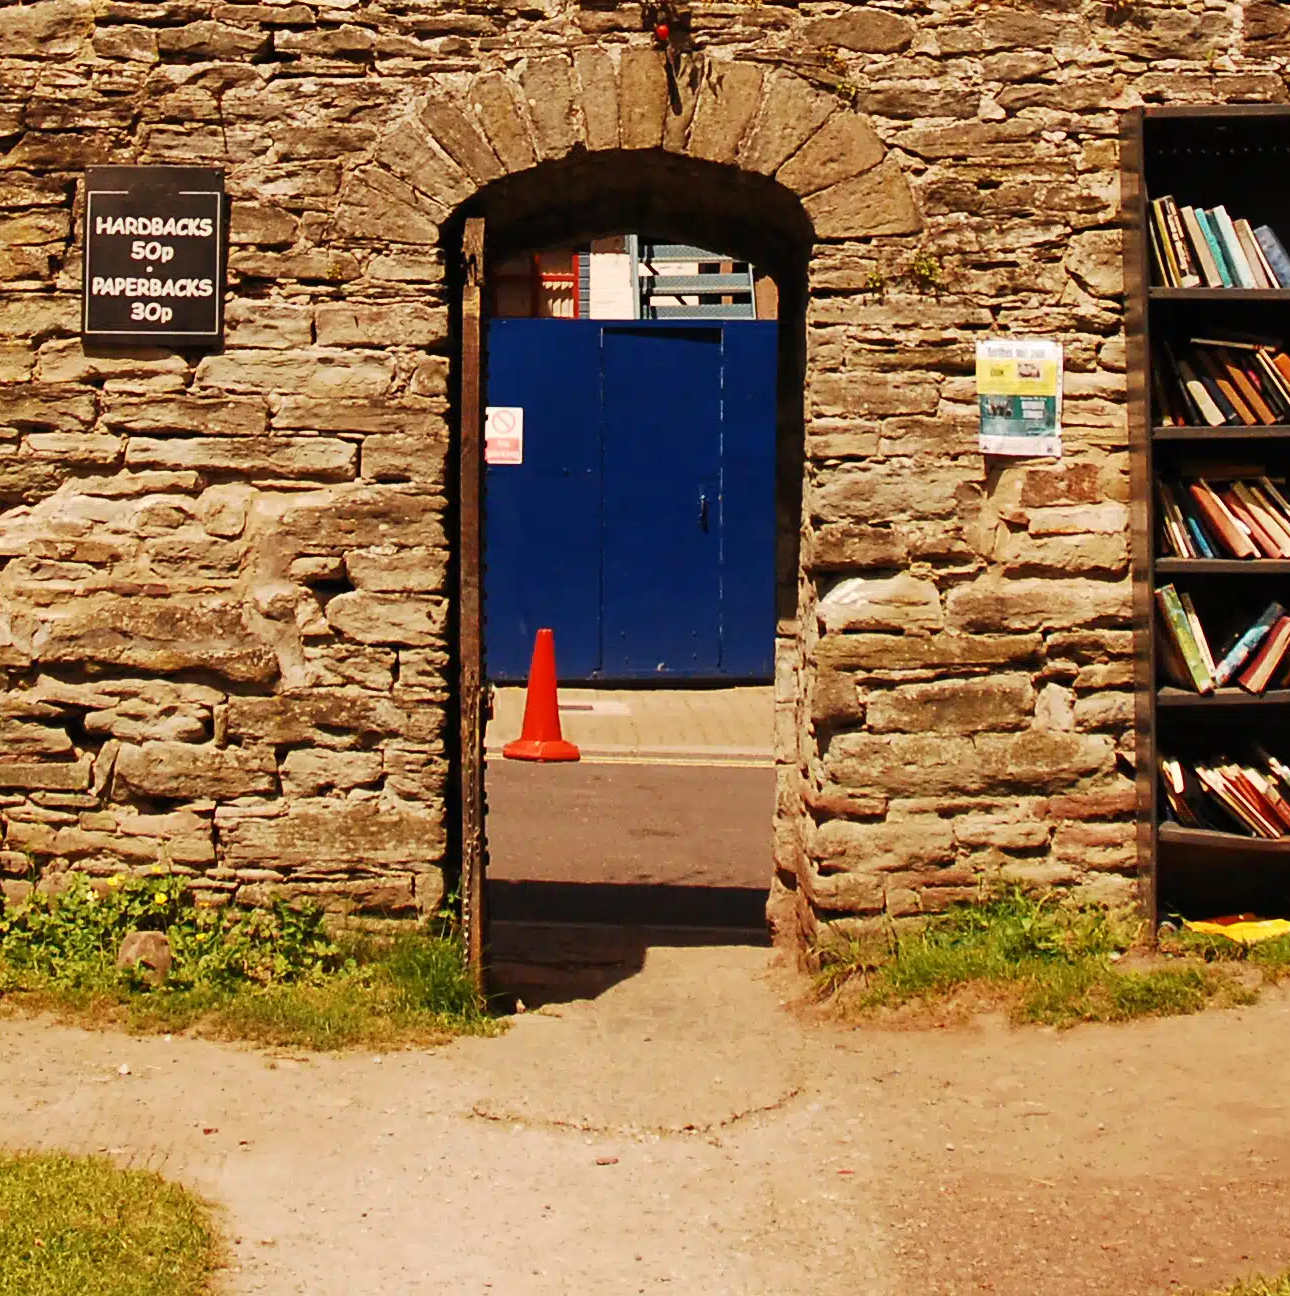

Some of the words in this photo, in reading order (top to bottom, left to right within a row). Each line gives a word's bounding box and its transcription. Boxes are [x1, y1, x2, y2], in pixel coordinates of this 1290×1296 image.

[95, 216, 213, 236] HARDBACKS
[130, 241, 174, 263] 50p
[91, 277, 213, 297] PAPERBACKS
[130, 302, 173, 323] 30p
